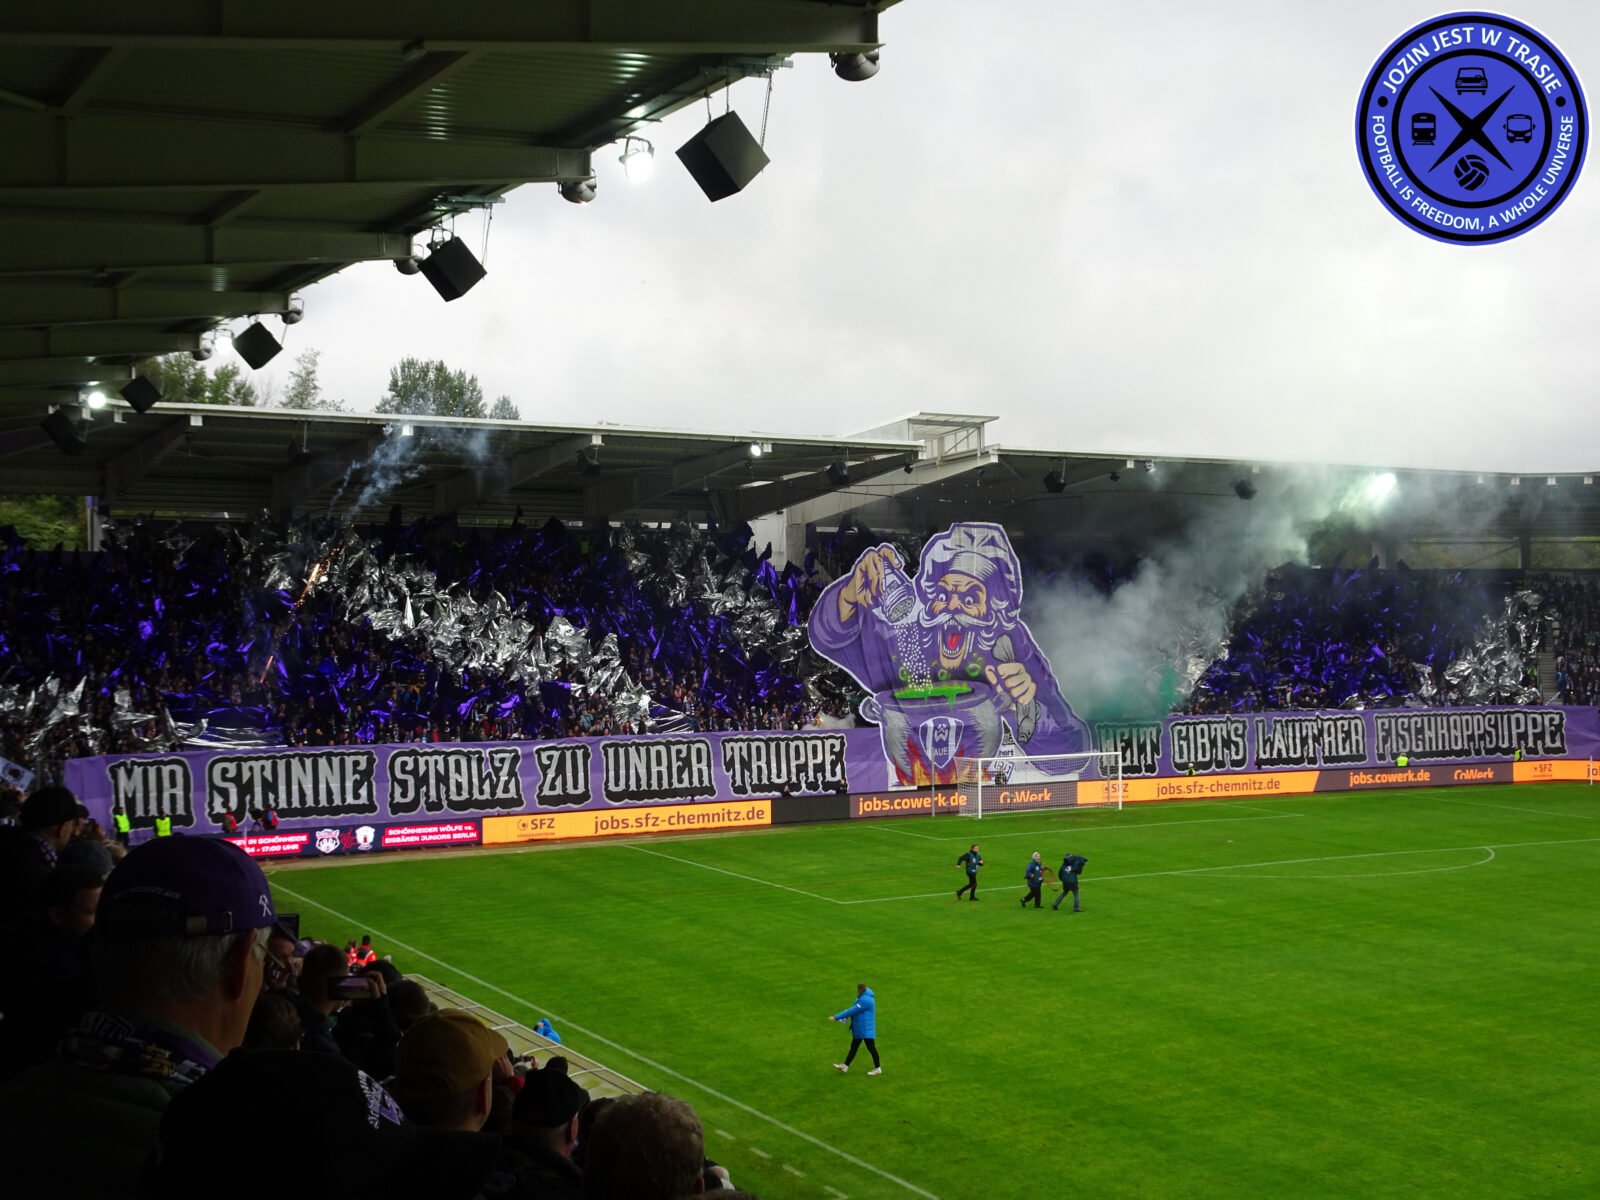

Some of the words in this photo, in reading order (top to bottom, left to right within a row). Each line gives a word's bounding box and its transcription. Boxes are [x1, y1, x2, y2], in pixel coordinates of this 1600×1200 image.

[1171, 719, 1247, 765] GIBT'S
[1256, 716, 1367, 761] LAUT'RER
[1375, 711, 1564, 755] FISCHKOPPSUPPE
[209, 752, 371, 816] STINNE
[391, 748, 521, 811] STOLZ
[537, 744, 589, 802] ZU
[722, 735, 845, 789] TRUPPE
[1453, 768, 1495, 780] CoWerk
[1538, 763, 1553, 773] SFZ
[1349, 769, 1431, 787] jobs.cowerk.de
[1111, 783, 1129, 793] SZ
[1156, 778, 1281, 797] jobs.sfz-chemnitz.de
[439, 824, 463, 832] WÖLFE
[531, 818, 555, 829] SFZ
[594, 807, 765, 834] jobs.sfz-chemnitz.de
